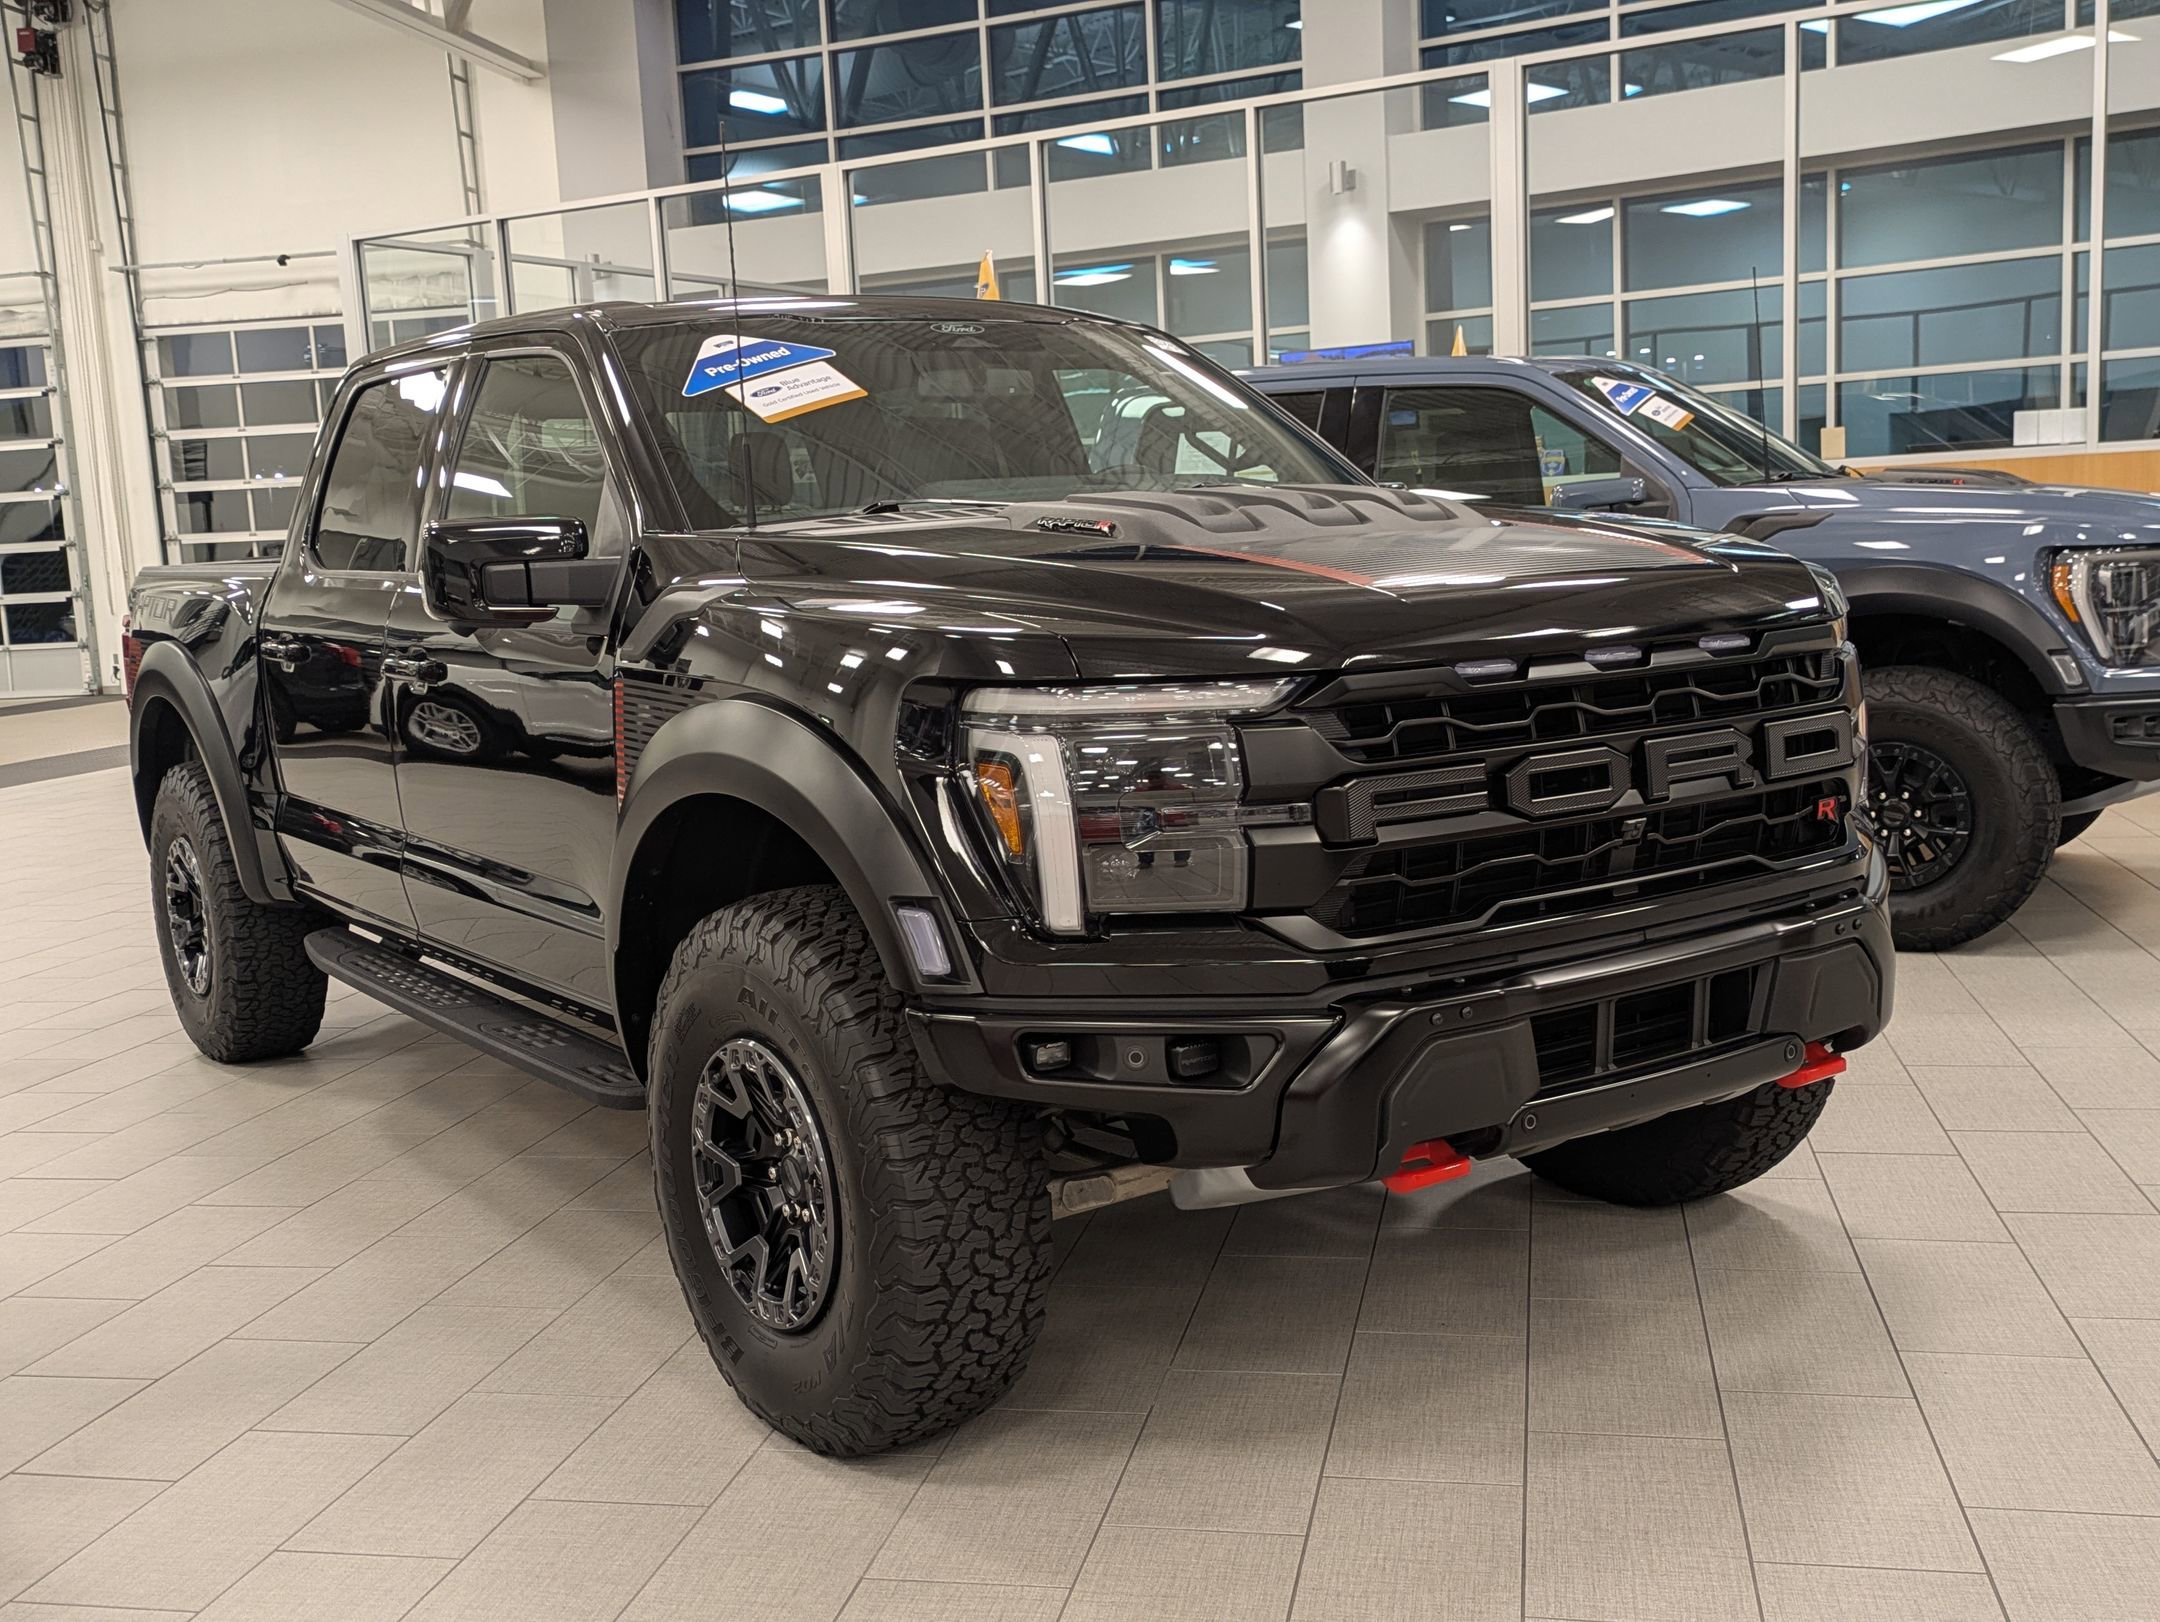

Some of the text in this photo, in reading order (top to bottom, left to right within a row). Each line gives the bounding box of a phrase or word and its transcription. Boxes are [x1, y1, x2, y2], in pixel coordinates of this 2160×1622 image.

[704, 347, 791, 377] Pre-Owned
[786, 376, 832, 390] Advantage
[1330, 709, 1855, 844] FORD
[1817, 797, 1838, 821] R
